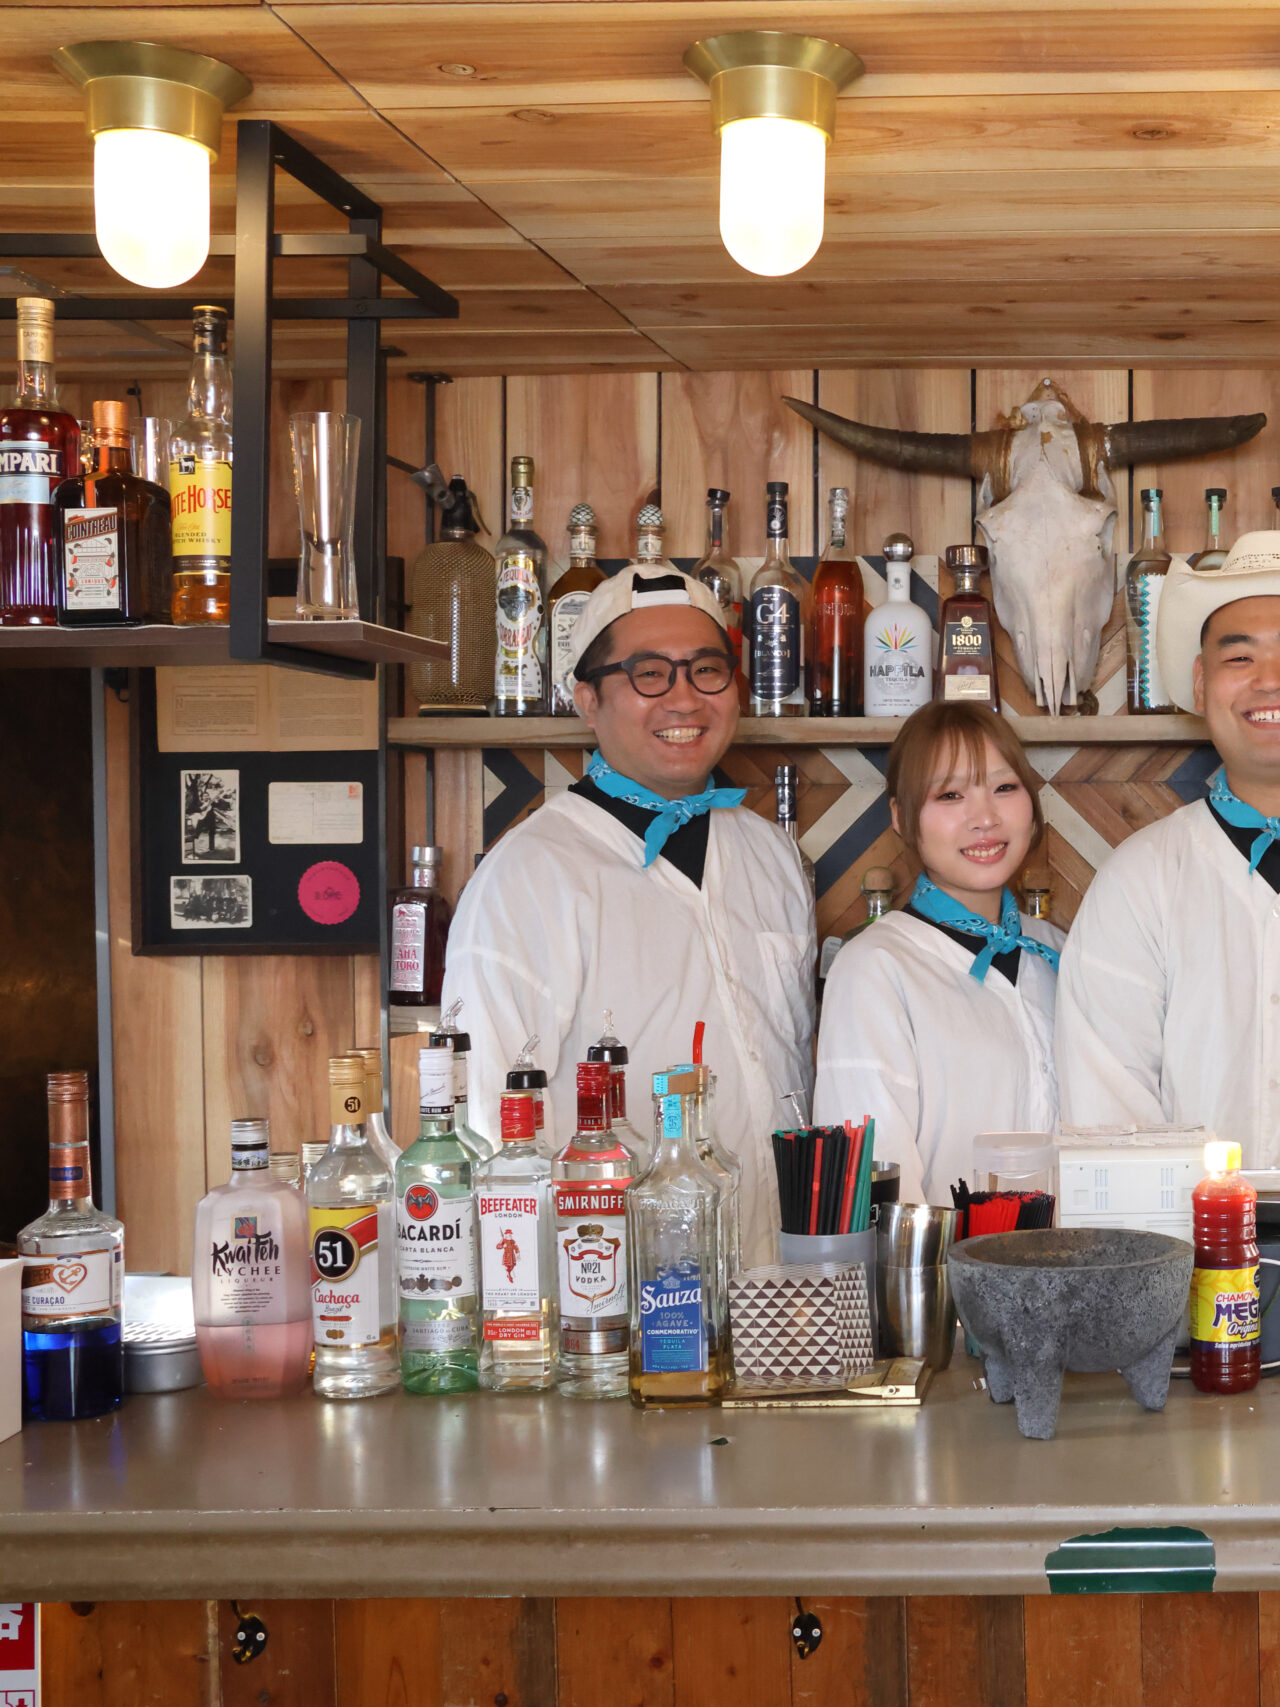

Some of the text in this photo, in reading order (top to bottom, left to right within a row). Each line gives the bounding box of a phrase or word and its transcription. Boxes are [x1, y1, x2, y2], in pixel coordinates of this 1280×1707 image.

[187, 485, 231, 514] HORSE
[67, 515, 117, 541] COINTREAU
[756, 602, 790, 624] G4
[952, 634, 982, 646] 1800
[395, 961, 419, 971] TORO
[346, 1099, 359, 1112] 51
[480, 1197, 537, 1216] BEEFEATER
[558, 1195, 624, 1210] SMIRNOFF
[210, 1230, 279, 1275] Kwai Feh
[318, 1240, 348, 1268] 51
[420, 1246, 455, 1254] BLANCA
[217, 1265, 281, 1277] LYCHEE
[575, 1275, 607, 1284] VODKA
[31, 1296, 66, 1307] CURAÇAO
[314, 1287, 360, 1309] Cachaça
[640, 1284, 703, 1315] Sauza
[1215, 1291, 1253, 1303] CHAMOY
[660, 1311, 685, 1319] 100%
